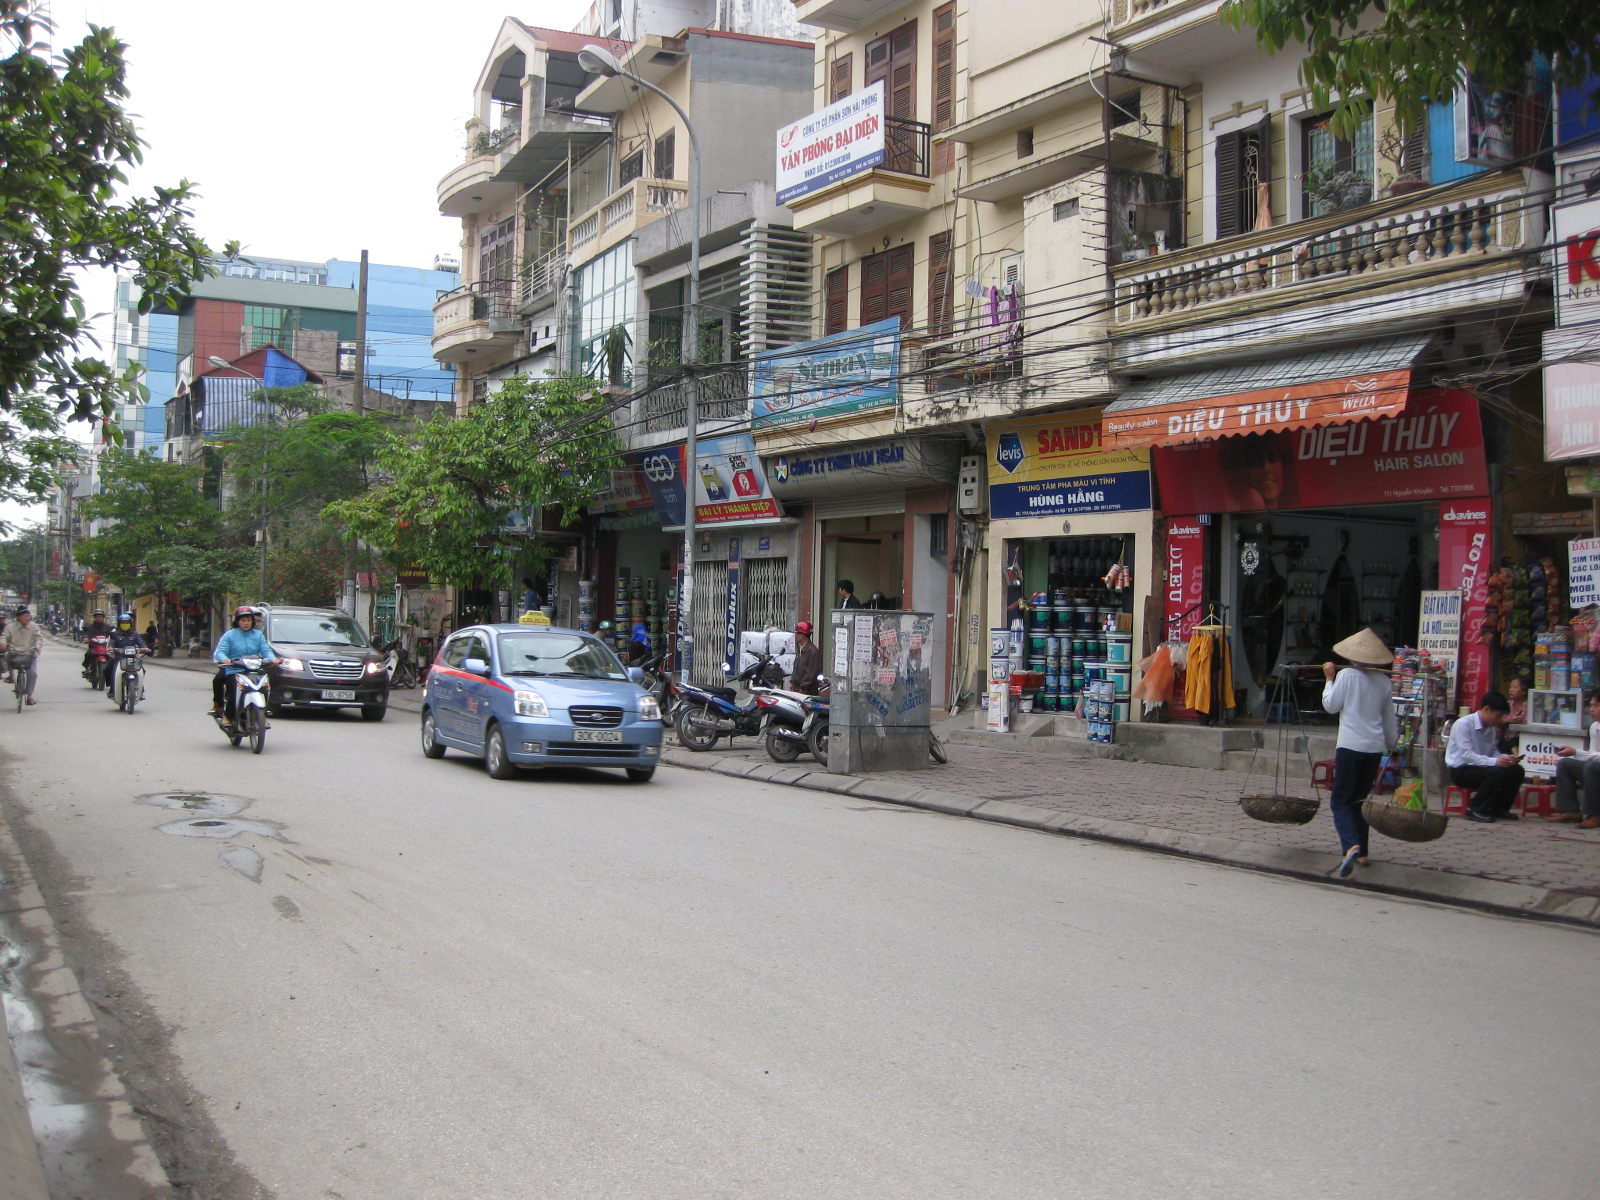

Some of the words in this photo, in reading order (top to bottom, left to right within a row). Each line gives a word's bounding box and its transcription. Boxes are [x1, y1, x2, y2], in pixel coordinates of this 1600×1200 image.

[781, 148, 801, 172] VĂN
[802, 136, 834, 165] PHÒNG
[835, 129, 853, 150] ĐẠI
[855, 113, 879, 140] DIỆN
[1167, 405, 1224, 437] DIỆU
[1237, 392, 1313, 427] THÚY
[1108, 421, 1135, 433] Beauty
[1137, 416, 1158, 428] salon
[1298, 421, 1368, 466] DIỆU
[1379, 405, 1461, 453] THÚY
[999, 444, 1022, 461] levis
[1374, 456, 1410, 472] HAIR
[1413, 452, 1464, 469] SALON
[1017, 484, 1040, 493] TRUNG
[1041, 482, 1057, 492] TÂM
[1057, 481, 1073, 490] PHA
[1073, 478, 1091, 488] MÀU
[1092, 479, 1098, 487] VI
[1099, 477, 1116, 486] TÍNH
[1029, 493, 1064, 508] HÙNG
[1067, 488, 1105, 505] HẰNG
[723, 503, 750, 514] THANH
[1570, 574, 1593, 583] VINA
[1570, 584, 1595, 593] MOBI
[728, 582, 738, 640] Dulux
[1526, 742, 1555, 754] calci
